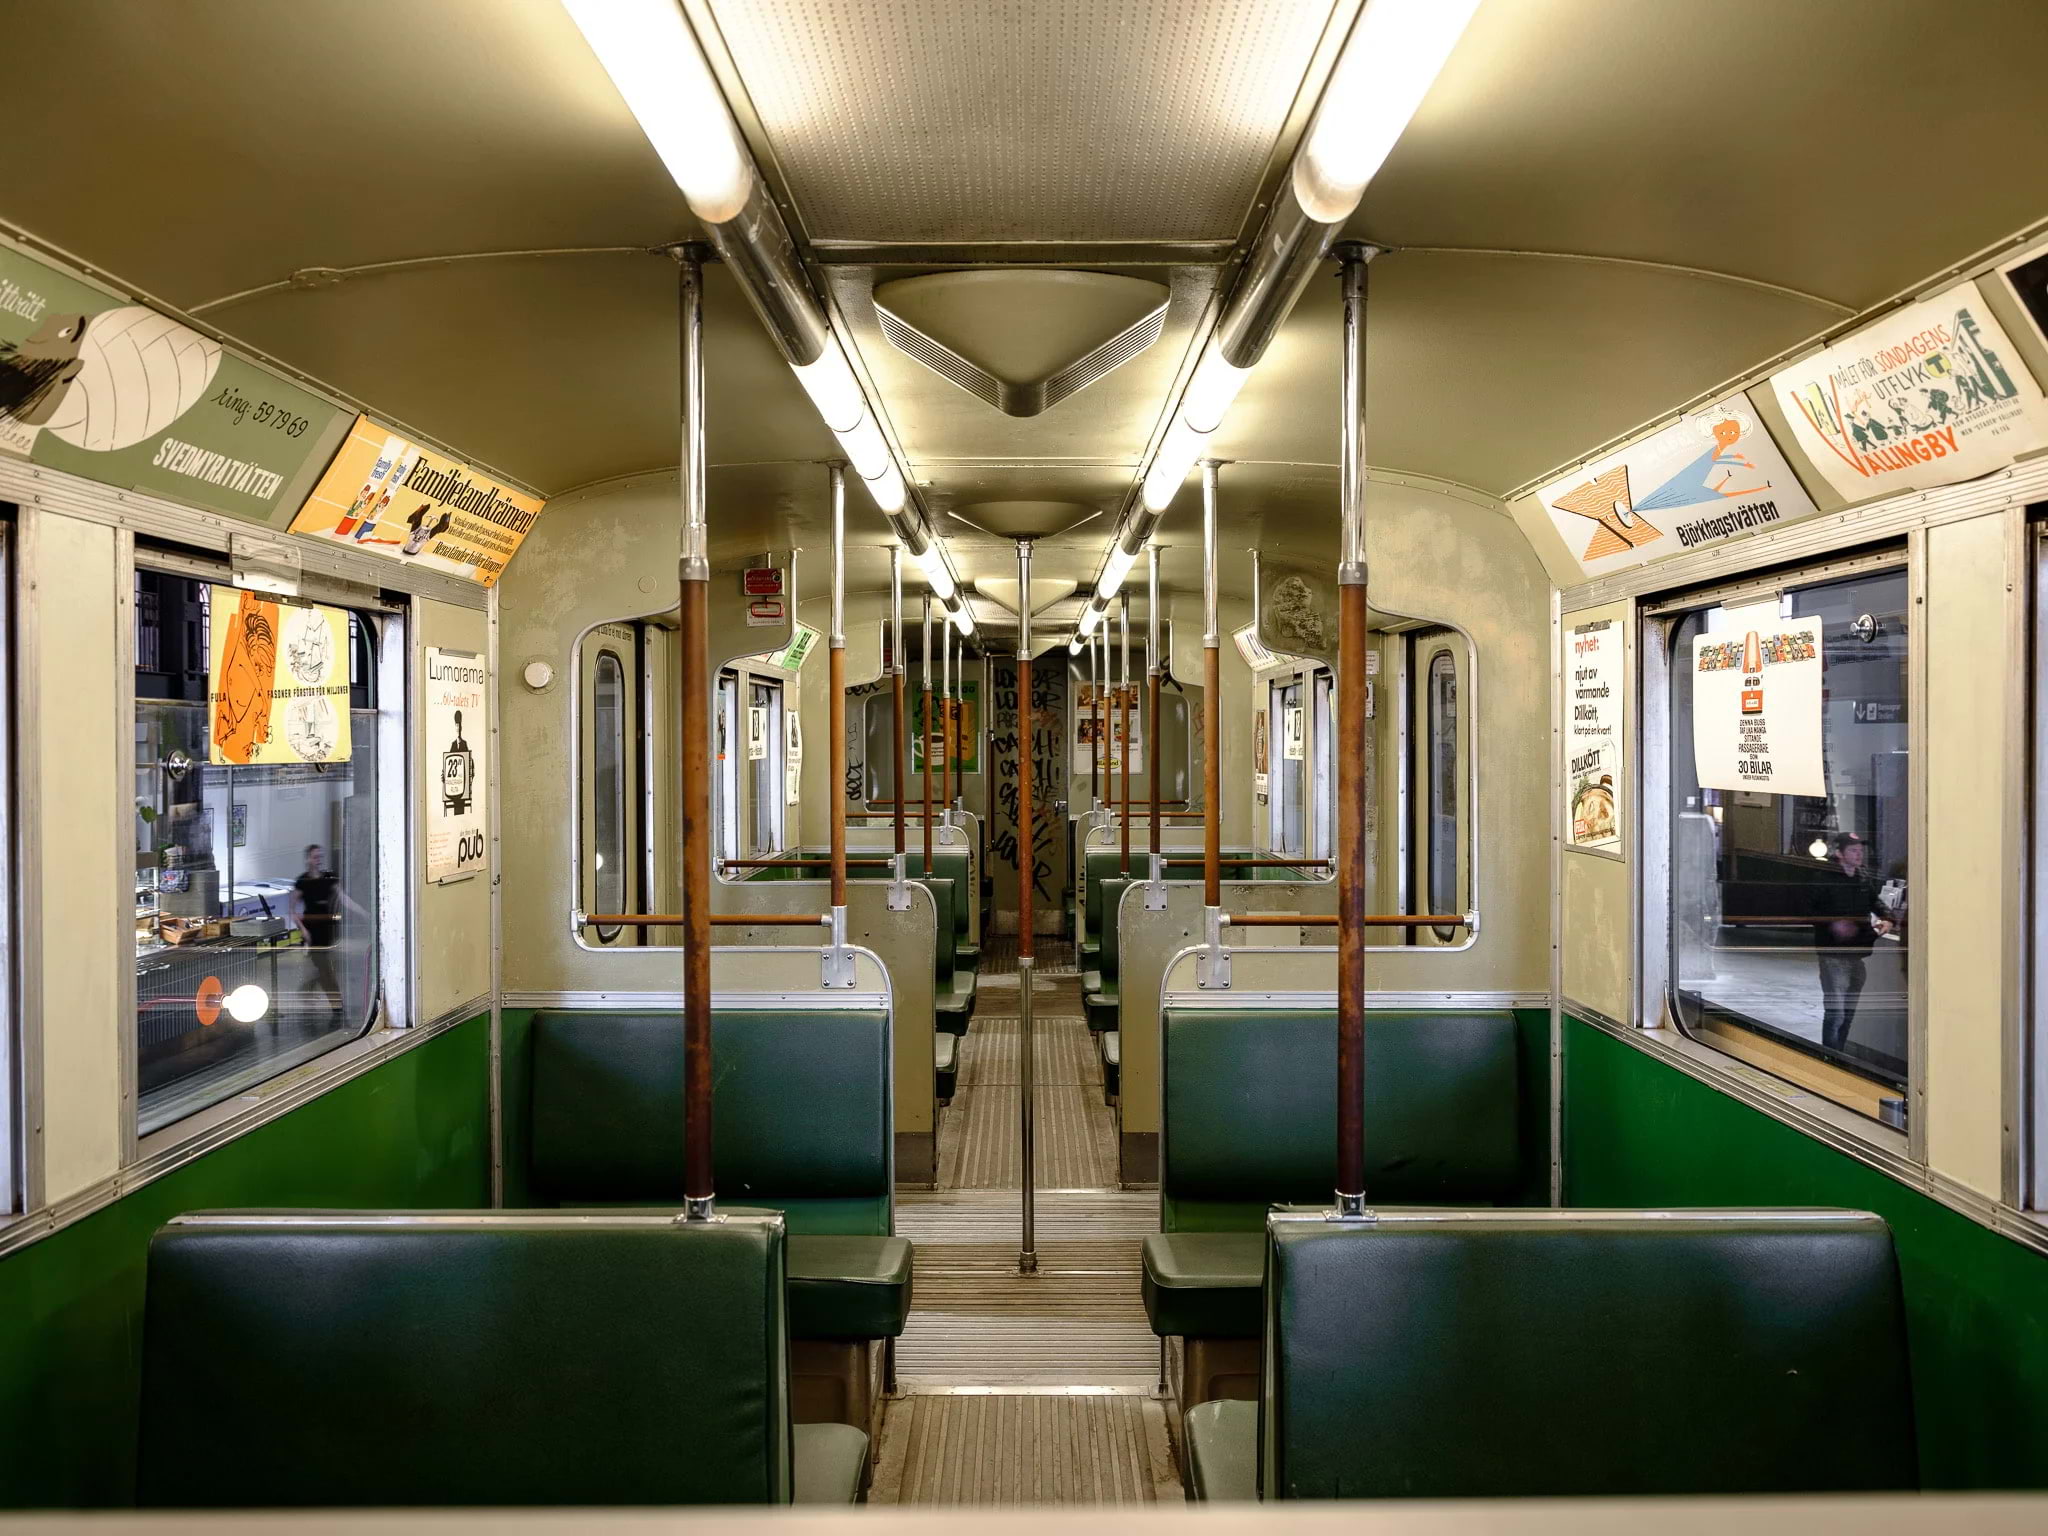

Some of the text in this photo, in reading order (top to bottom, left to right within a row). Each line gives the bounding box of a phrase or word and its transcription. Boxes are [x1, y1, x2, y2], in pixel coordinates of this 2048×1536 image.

[1833, 324, 1951, 390] MÅLET FÖR SÖNDAGENS
[1872, 353, 1946, 400] UTFLYKT
[211, 388, 252, 426] ring:
[153, 438, 284, 500] SVEDMYRATVÄTTEN
[402, 456, 538, 535] Familjetandkrämen!
[1676, 500, 1780, 547] Björkhagstvätten
[1575, 634, 1600, 659] nyhet:
[430, 657, 484, 684] Lumorama
[1575, 665, 1598, 683] njut av
[211, 685, 349, 703] FULA FASONER FÖRSTÖR FÖR MILJONER
[1575, 681, 1610, 699] värmande
[1740, 719, 1766, 727] DENNA BUSS
[1744, 735, 1762, 743] SITTANDE
[1571, 748, 1600, 774] DILLKÖTT
[1738, 760, 1773, 775] 30 BILAR
[457, 828, 484, 868] pub
